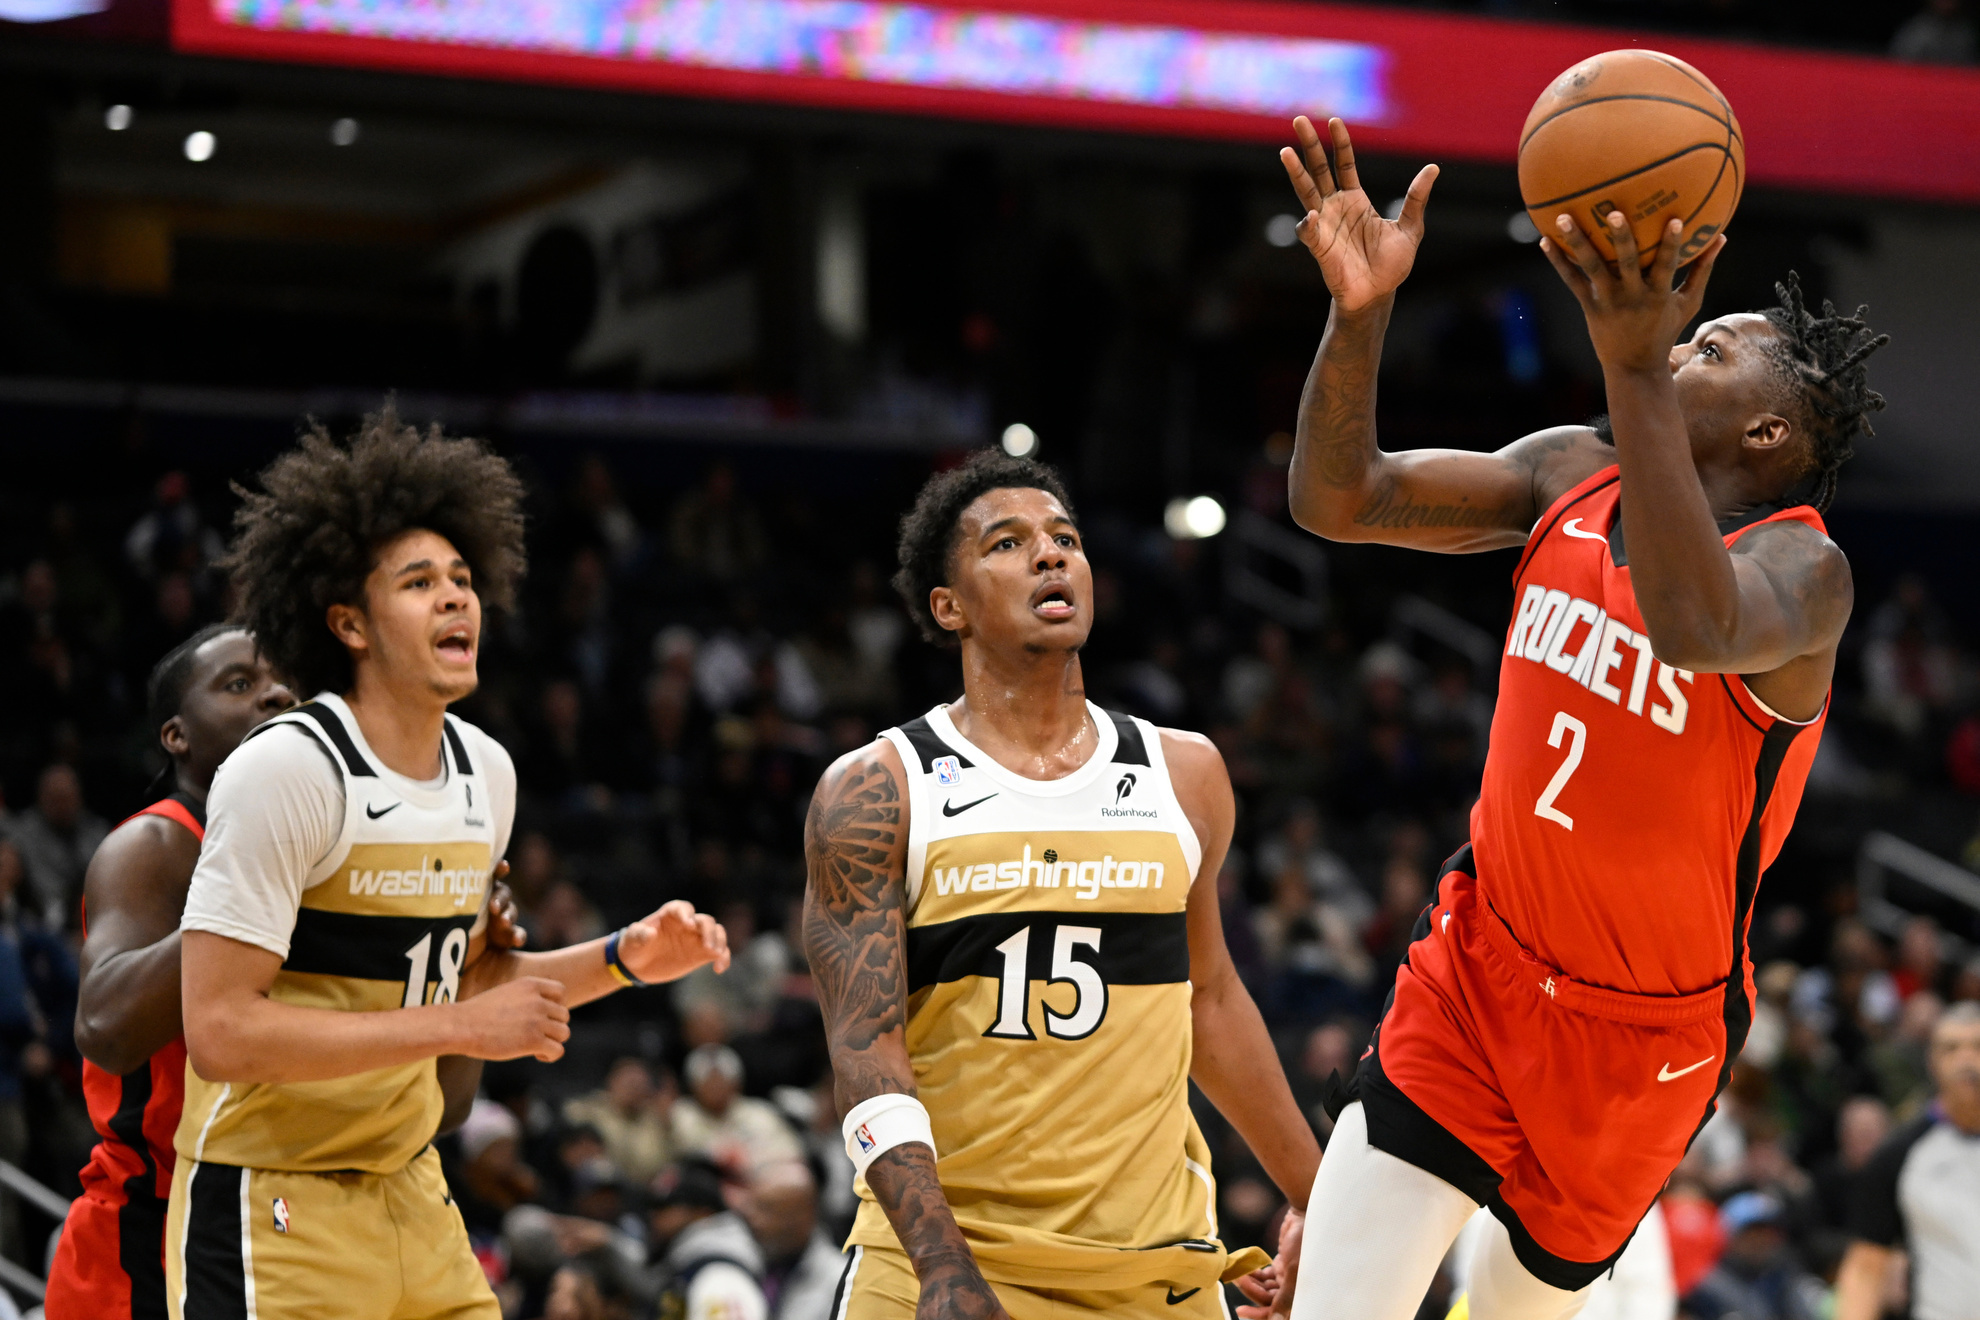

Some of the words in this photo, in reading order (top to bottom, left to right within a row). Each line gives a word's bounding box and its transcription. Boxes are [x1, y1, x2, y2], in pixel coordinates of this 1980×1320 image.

[1506, 583, 1695, 736] ROCKETS
[1101, 807, 1158, 819] Robinhood
[1534, 711, 1587, 832] 2
[933, 843, 1164, 900] washington
[402, 927, 469, 1008] 18
[982, 924, 1109, 1041] 15
